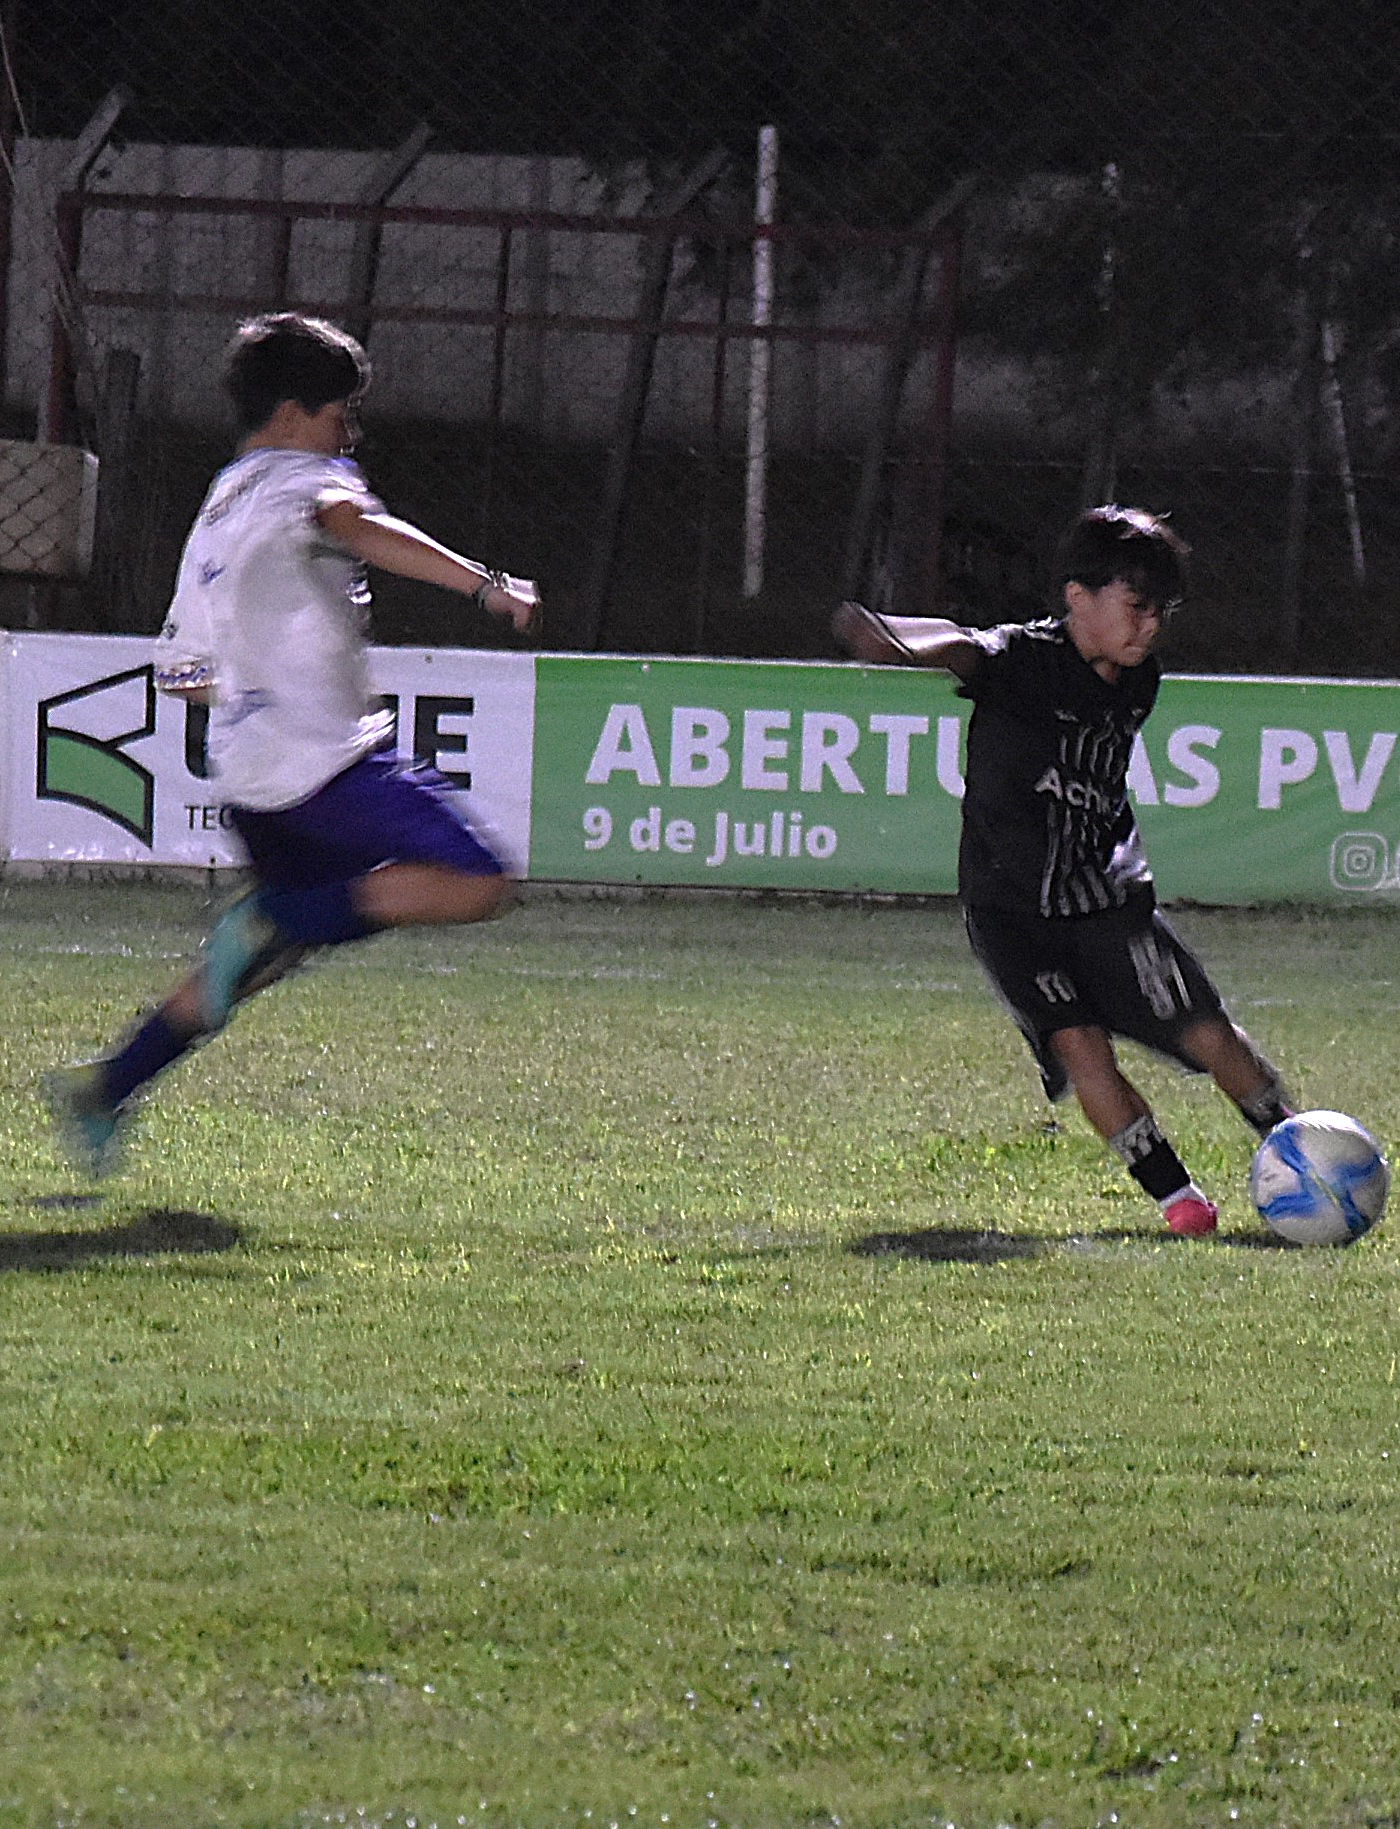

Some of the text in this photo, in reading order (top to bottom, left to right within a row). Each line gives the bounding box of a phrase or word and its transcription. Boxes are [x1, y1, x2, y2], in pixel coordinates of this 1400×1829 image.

[586, 704, 1221, 807] ABERTUAS
[582, 806, 838, 867] 9 de Julio
